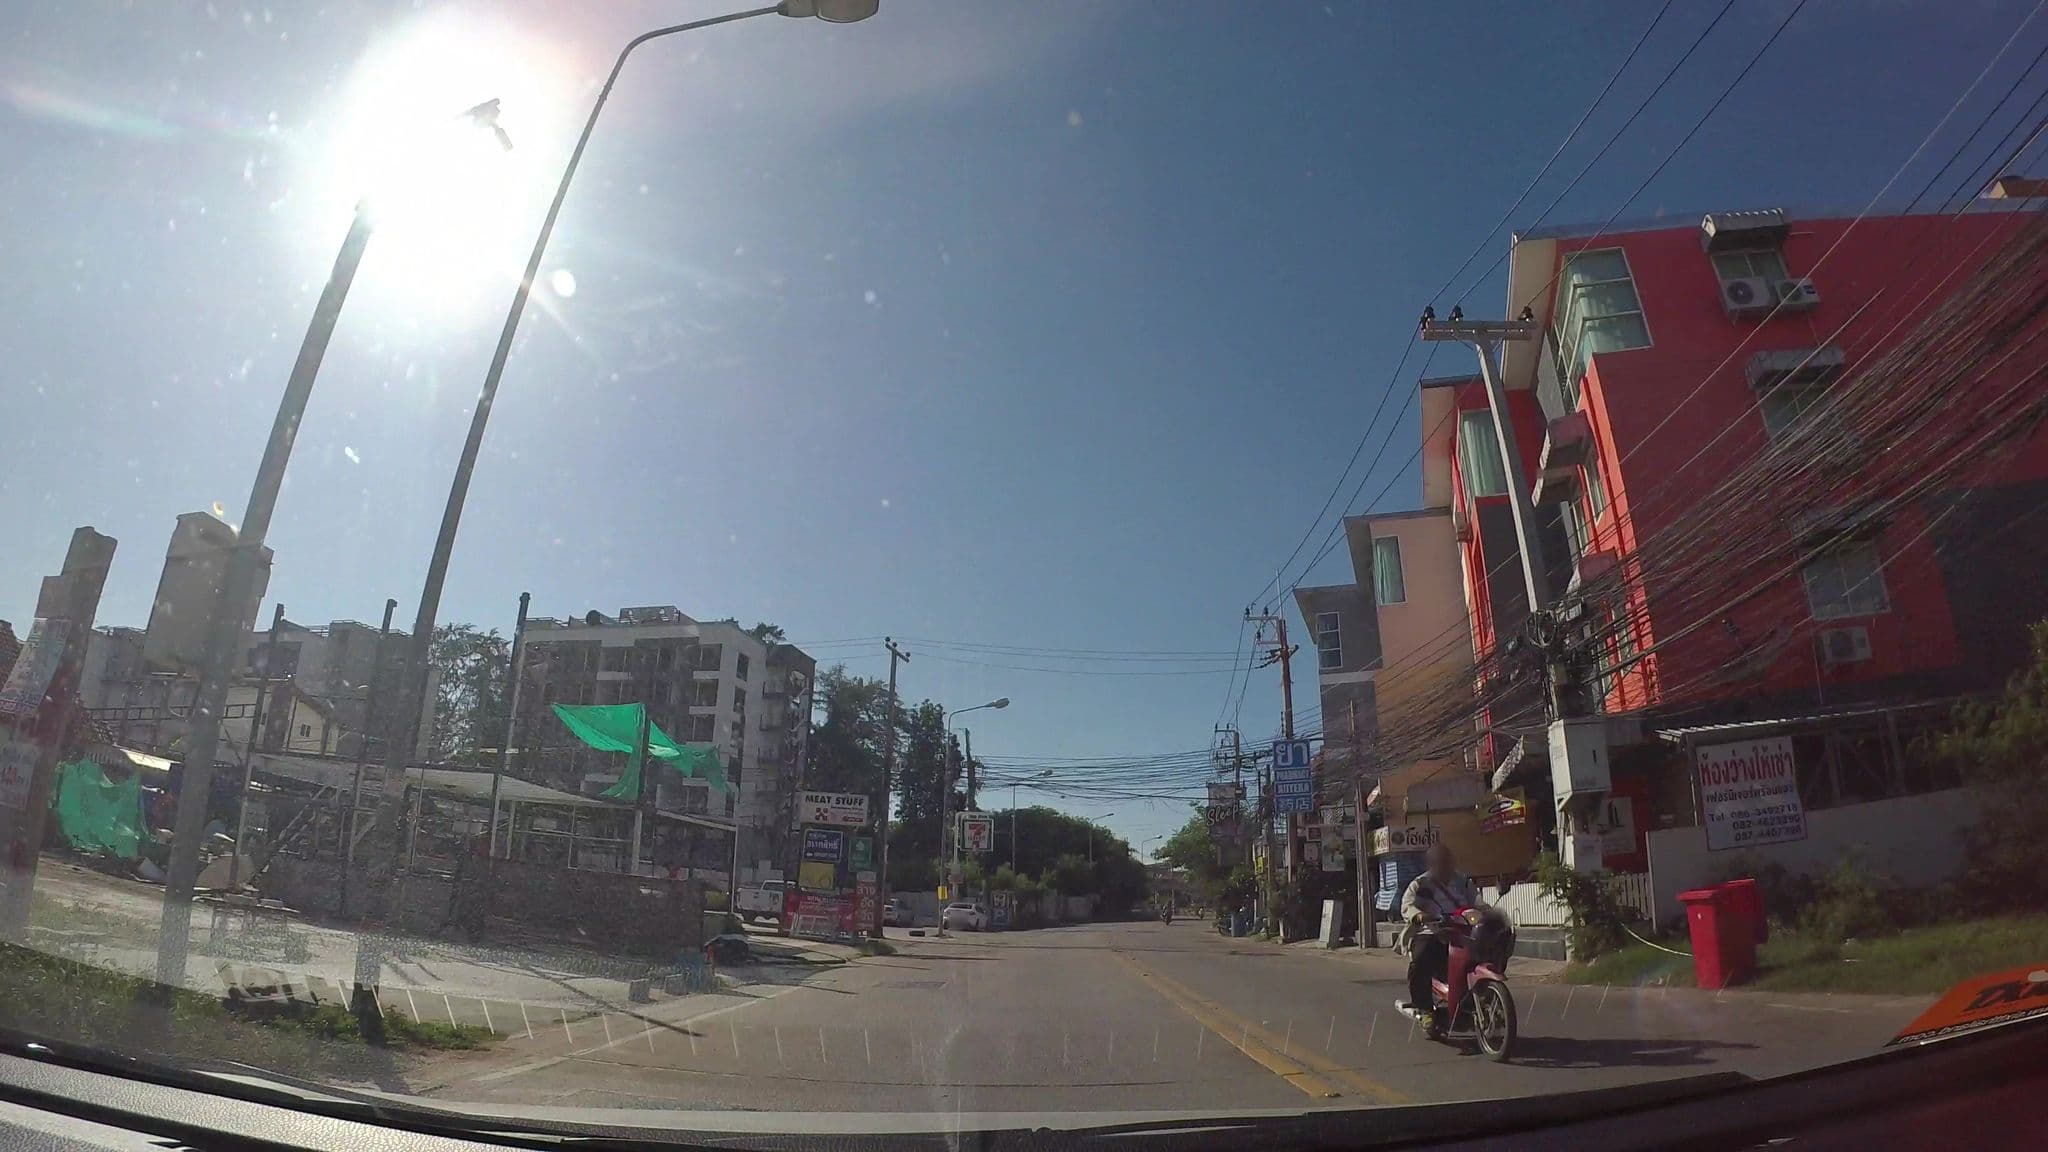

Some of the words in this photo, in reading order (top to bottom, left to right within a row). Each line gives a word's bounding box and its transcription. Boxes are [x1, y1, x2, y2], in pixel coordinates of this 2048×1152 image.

[1275, 742, 1308, 766] ยา
[1700, 743, 1794, 786] ห้องว่างให้เช่า
[805, 794, 832, 804] MEAT
[835, 796, 864, 807] STUFF
